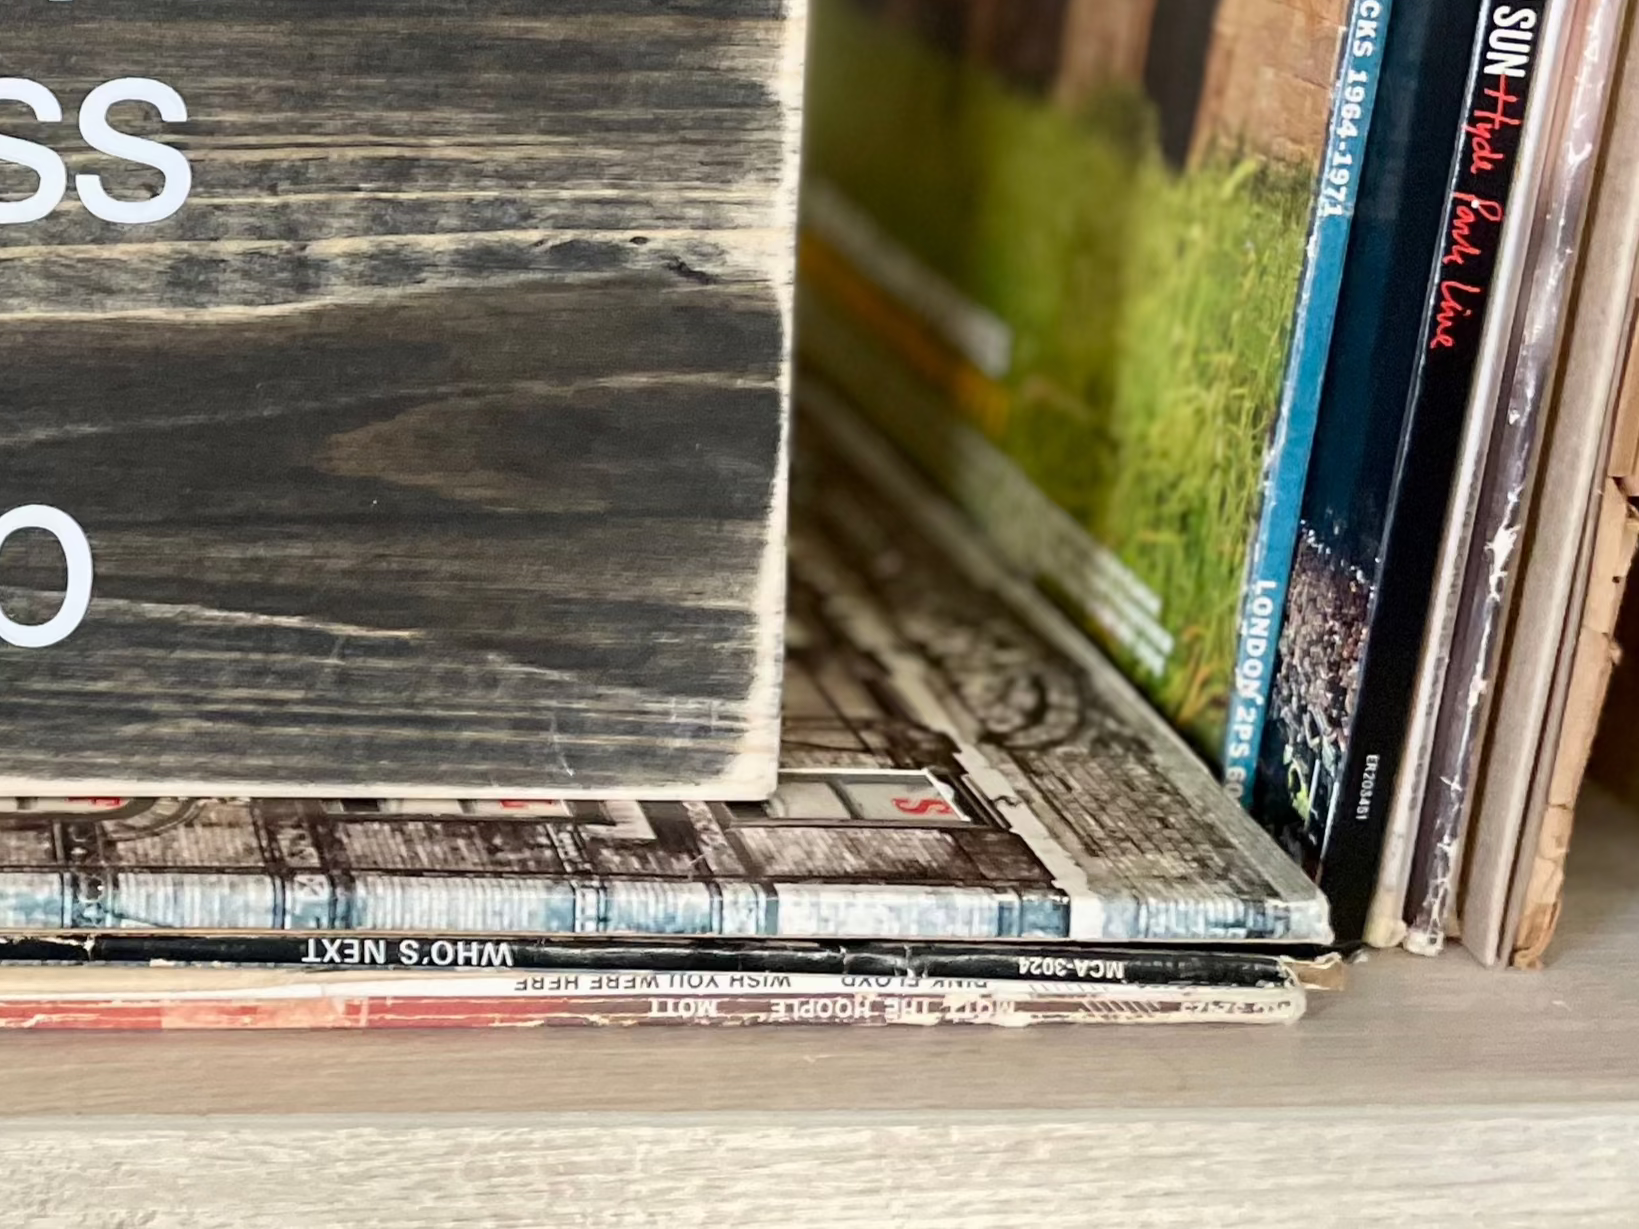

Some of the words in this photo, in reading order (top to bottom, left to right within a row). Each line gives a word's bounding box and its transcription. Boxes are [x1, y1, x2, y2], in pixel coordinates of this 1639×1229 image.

[1482, 3, 1535, 81] SUN
[1460, 70, 1520, 176] Hyde
[1316, 67, 1368, 218] 1964-1971
[1439, 190, 1498, 271] Park
[1238, 578, 1277, 699] LONDON
[1228, 705, 1256, 758] 2PS
[1222, 765, 1244, 804] 60
[302, 938, 387, 965] NEXT
[399, 939, 513, 966] WHO'S
[1017, 956, 1126, 979] MCA-3024
[514, 975, 578, 991] HERE
[589, 975, 659, 991] WERE
[669, 975, 719, 991] YOU
[730, 975, 791, 991] WISH
[648, 996, 719, 1019] MOTT
[769, 998, 873, 1019] HOOPLE
[883, 999, 931, 1018] THE
